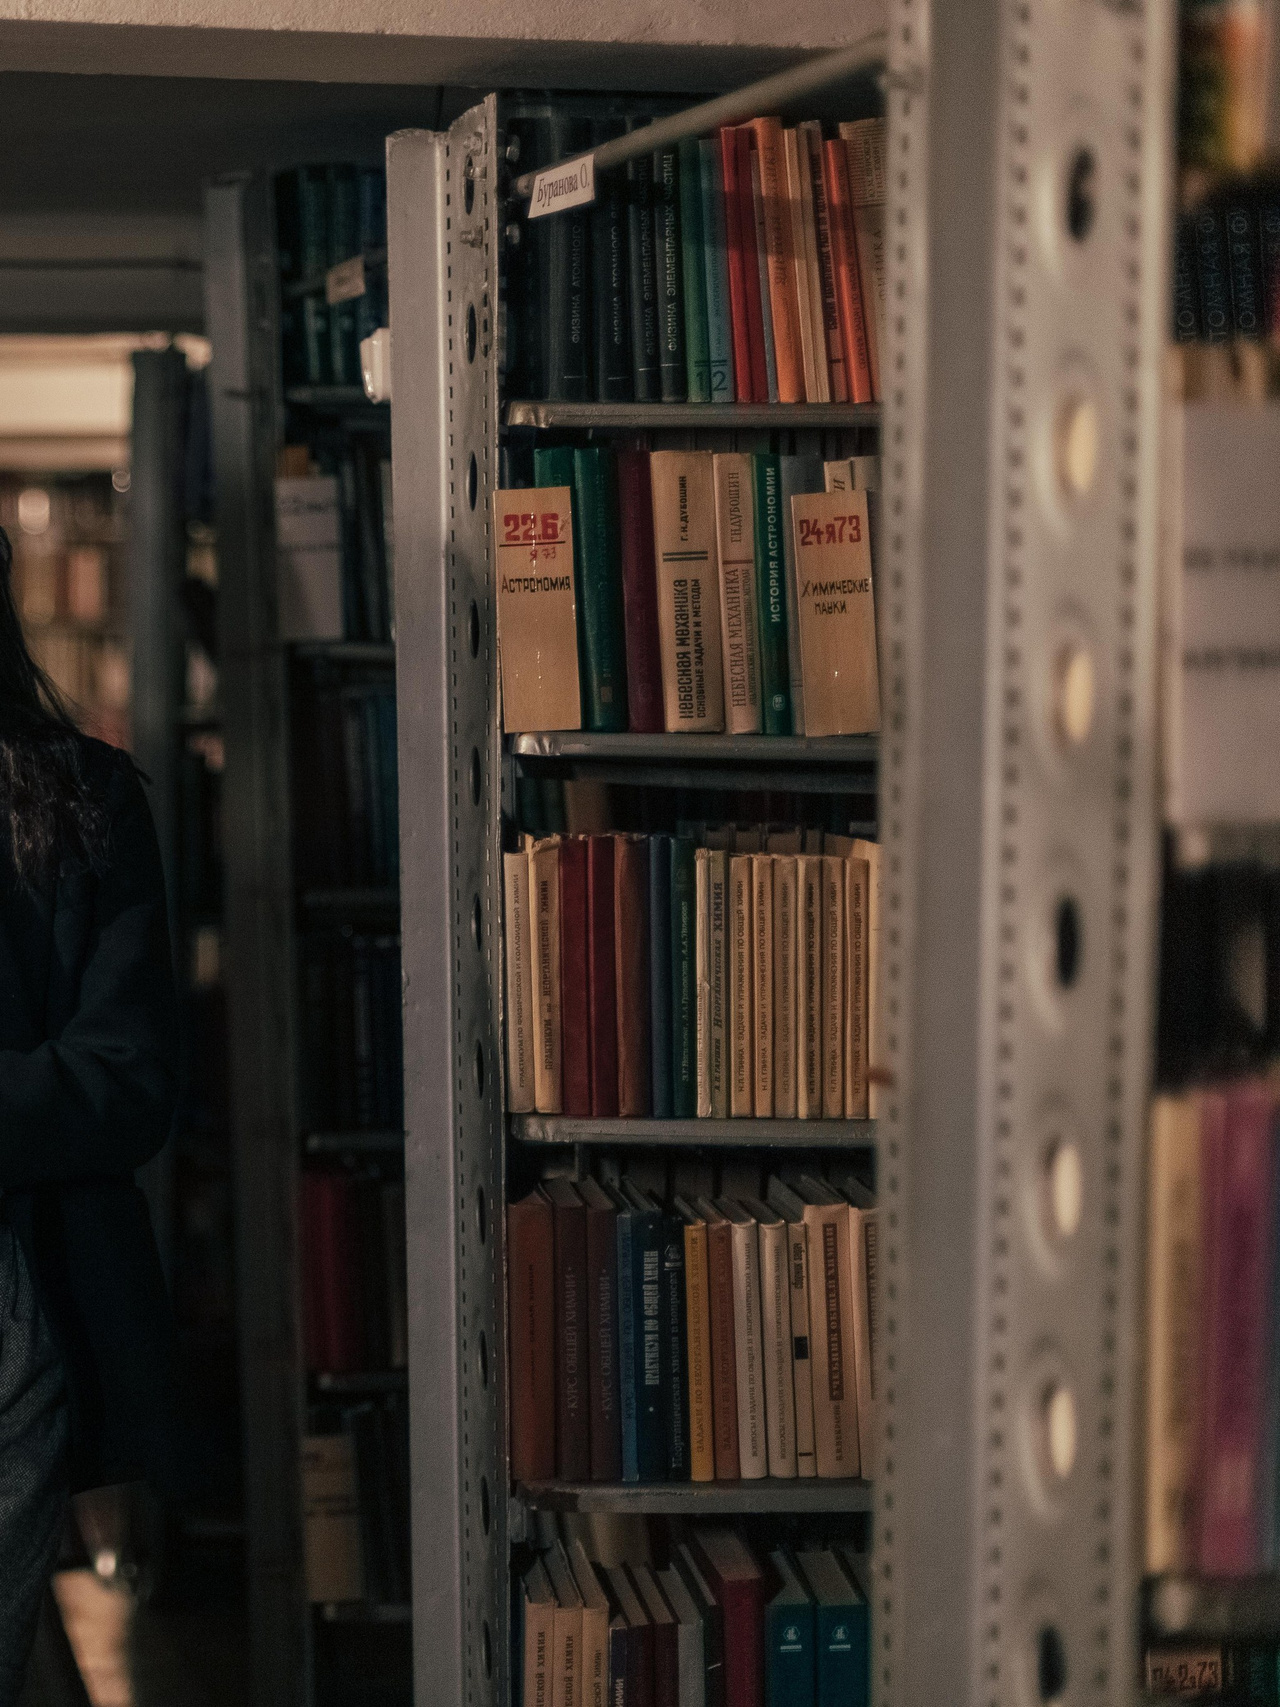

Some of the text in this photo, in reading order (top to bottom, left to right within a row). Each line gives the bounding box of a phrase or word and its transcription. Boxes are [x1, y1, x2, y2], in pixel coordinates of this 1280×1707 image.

[536, 173, 579, 208] Буранова
[580, 163, 591, 189] О.
[571, 225, 581, 288] АТОМНОГО
[639, 208, 652, 301] ЭЛЕМЕНТАРНЫХ
[662, 153, 678, 352] ФИЗИКА ЭЛЕМЕНТАРНЫХ ЧАСТИЦ
[570, 294, 581, 344] ФИЗИКА
[642, 306, 655, 356] ФИЗИКА
[712, 370, 728, 392] 2
[765, 466, 783, 623] ИСТОРИЯ АСТРОНОМИИ
[690, 579, 702, 618] МЕТОДЫ
[801, 578, 870, 599] ХИМИЧЕСКИЕ
[814, 600, 849, 616] НАУКИ
[693, 630, 705, 667] ЗАДАЧИ
[724, 568, 747, 707] НЕБЕСНАЯ МЕХАНИКА
[512, 874, 520, 904] ХИМИИ
[712, 882, 723, 933] ХИМИЯ
[512, 907, 522, 961] КОЛЛОИДНОЙ
[734, 909, 744, 937] ОБЩЕЙ
[756, 909, 766, 938] ОБЩЕЙ
[806, 911, 816, 940] ОБЩЕЙ
[828, 909, 838, 938] ОБЩЕЙ
[851, 911, 862, 940] ОБЩЕЙ
[514, 971, 524, 1025] ФИЗИЧЕСКОЙ
[539, 880, 554, 1070] ПРАКТИКУМ НЕОРГАНИЧЕСКОЙ ХИМИИ
[736, 952, 745, 1001] УПРАЖНЕНИЯ
[758, 951, 768, 1002] УПРАЖНЕНИЯ
[829, 952, 838, 1002] УПРАЖНЕНИЯ
[853, 954, 862, 1004] УПРАЖНЕНИЯ
[516, 1027, 525, 1038] ПО
[737, 1012, 746, 1041] ЗАДАЧИ
[760, 1011, 769, 1041] ЗАДАЧИ
[829, 1012, 840, 1042] ЗАДАЧИ
[852, 1014, 862, 1044] ЗАДАЧИ
[516, 1039, 526, 1089] ПРАКТИКУМ
[642, 1250, 661, 1386] ПРАКТИКУМ ПО ОБЩЕЙ ХИМИИ
[669, 1271, 682, 1325] вопросах
[825, 1225, 842, 1397] УЧЕБНИК ОБЩЕЙ ХИМИИ
[564, 1273, 579, 1410] КУРС ОБЩЕЙ ХИМИИ
[598, 1275, 613, 1412] КУРС ОБЩЕЙ ХИМИИ
[671, 1336, 680, 1374] химия
[690, 1282, 703, 1387] НЕОРГАНИЧЕСКОЙ
[693, 1389, 703, 1405] ПО
[670, 1376, 685, 1469] Неорганическая
[694, 1407, 705, 1454] ЗАДАЧИ
[537, 1631, 546, 1668] ХИМИИ
[565, 1635, 574, 1671] ХИМИИ
